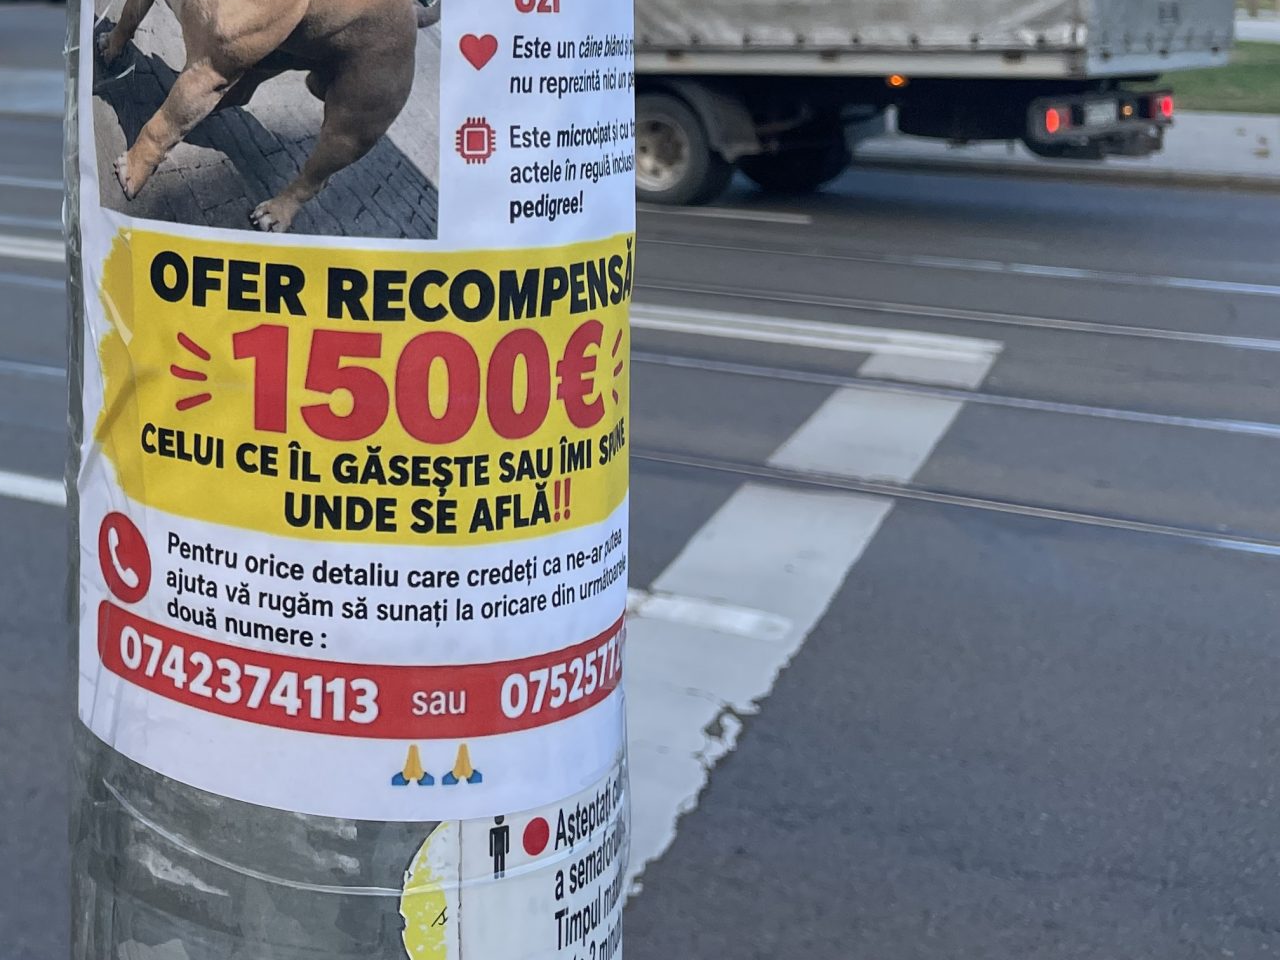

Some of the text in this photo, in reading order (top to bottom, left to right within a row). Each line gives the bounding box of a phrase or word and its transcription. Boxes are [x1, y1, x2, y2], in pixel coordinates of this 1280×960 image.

[512, 35, 551, 59] Este
[557, 41, 575, 59] un
[578, 34, 602, 59] câine
[509, 75, 533, 94] nu
[539, 68, 600, 99] reprezintă
[602, 67, 616, 90] nici
[509, 125, 551, 149] Este
[556, 120, 611, 149] microcipat
[620, 123, 629, 141] cu
[510, 160, 561, 184] actele
[565, 158, 576, 181] în
[580, 154, 611, 184] regulă
[509, 190, 584, 224] pedigree!
[150, 236, 634, 322] OFER RECOMPENSĂ
[231, 319, 606, 445] 1500€
[141, 422, 224, 469] CELUI
[236, 442, 278, 477] CE
[288, 440, 321, 483] ÎL
[332, 445, 490, 497] GĂSEȘTE
[498, 447, 553, 483] SAU
[559, 435, 592, 475] ÎMI
[284, 478, 571, 534] UNDE SE AFLĂ!!
[167, 531, 237, 569] Pentru
[244, 554, 305, 580] orice
[312, 560, 399, 587] detaliu
[407, 569, 460, 588] care
[467, 556, 538, 587] credeți
[543, 556, 561, 577] ca
[566, 545, 603, 572] ne-ar
[166, 568, 218, 598] ajuta
[225, 582, 250, 605] vă
[258, 592, 333, 618] rugăm
[341, 596, 368, 620] să
[376, 599, 448, 628] sunați
[456, 598, 473, 621] la
[481, 592, 547, 619] oricare
[551, 584, 575, 609] din
[166, 598, 217, 629] două
[225, 616, 314, 647] numere
[120, 624, 380, 724] 0742374113
[411, 690, 466, 716] sau
[555, 869, 564, 901] a
[555, 884, 601, 951] Timpul
